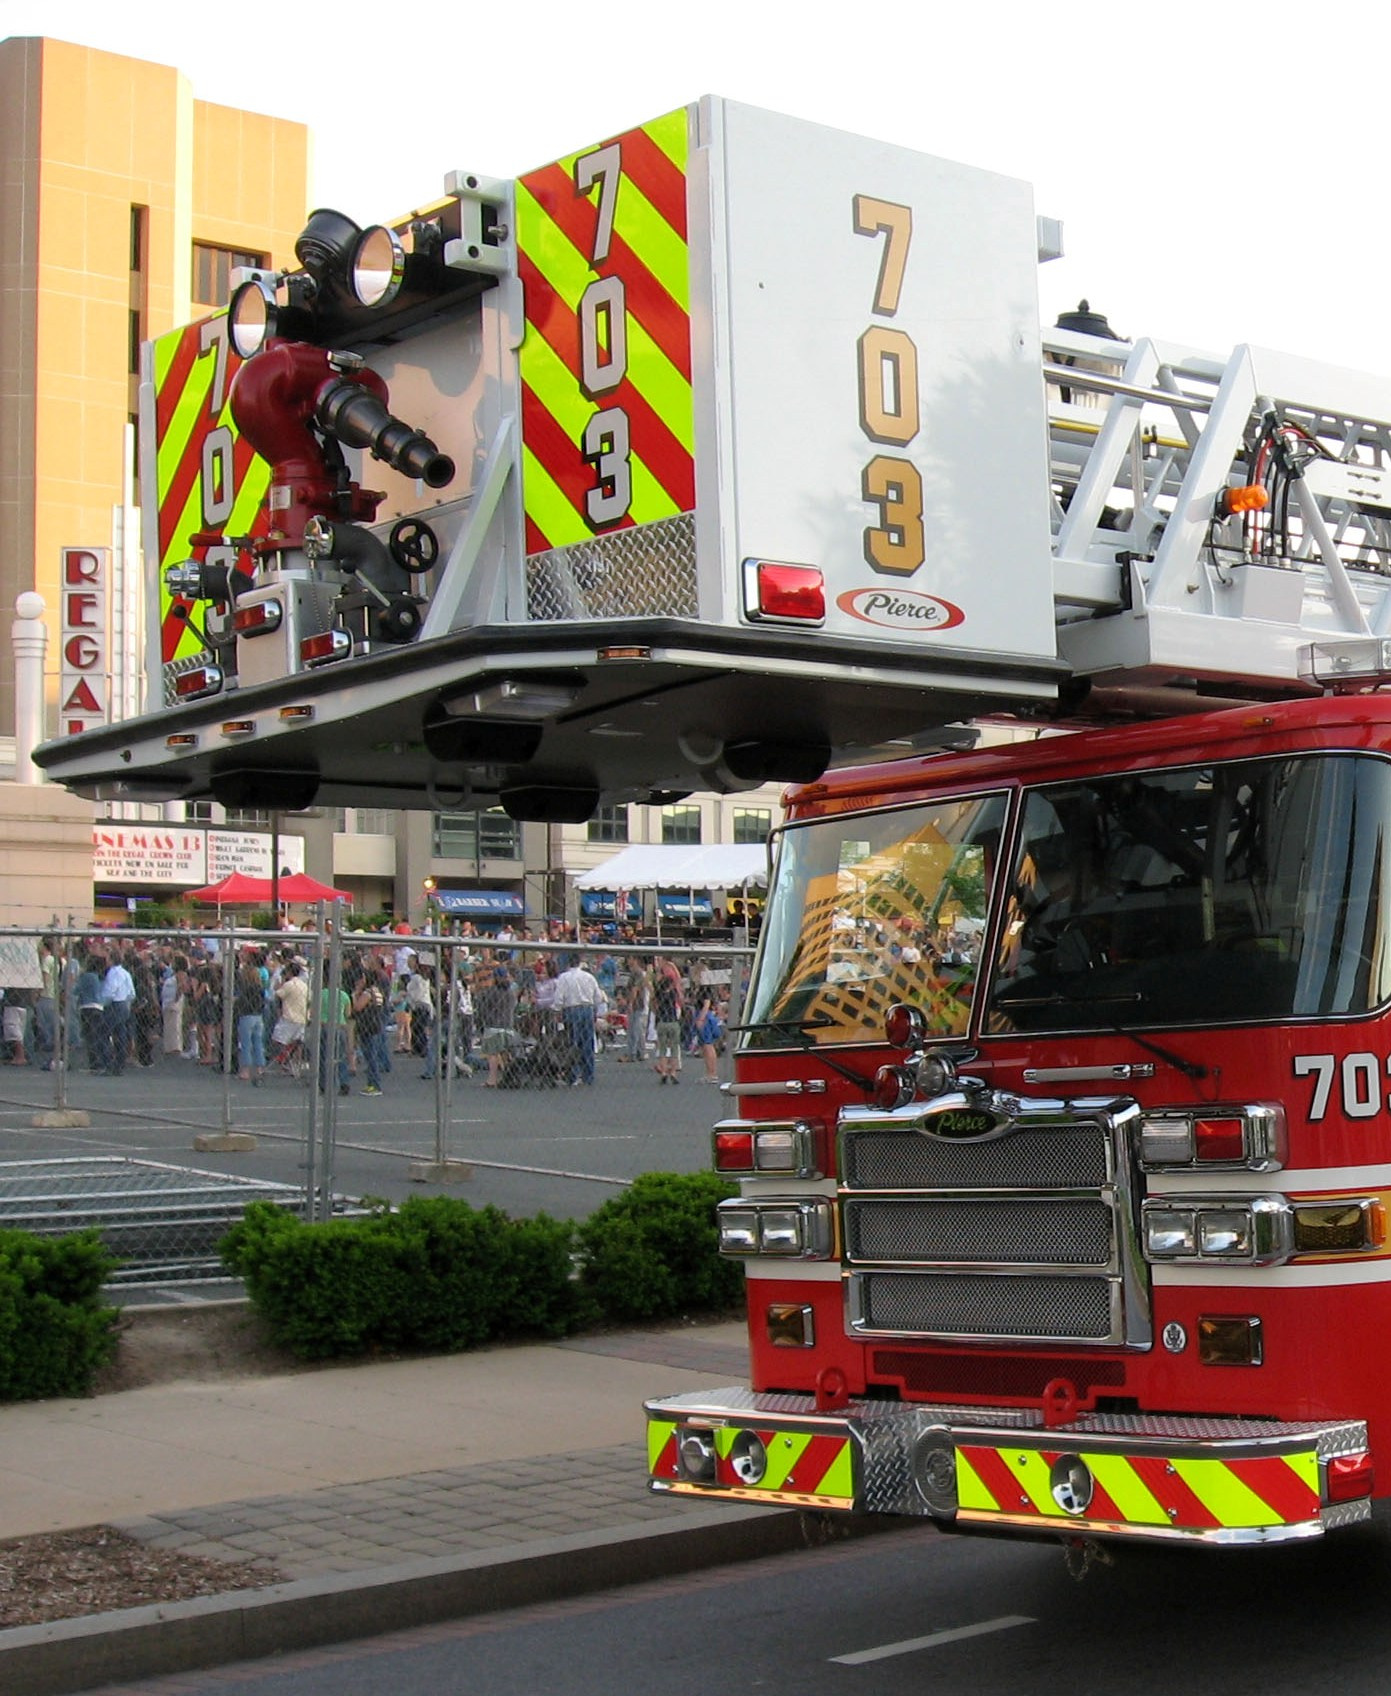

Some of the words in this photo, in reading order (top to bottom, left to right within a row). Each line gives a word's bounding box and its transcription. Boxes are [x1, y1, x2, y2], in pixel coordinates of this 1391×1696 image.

[573, 142, 633, 536] 703
[852, 193, 926, 578] 703
[863, 593, 938, 620] Pierce
[93, 832, 174, 850] INEMAS
[182, 836, 201, 851] 13
[937, 1111, 986, 1135] Pierce
